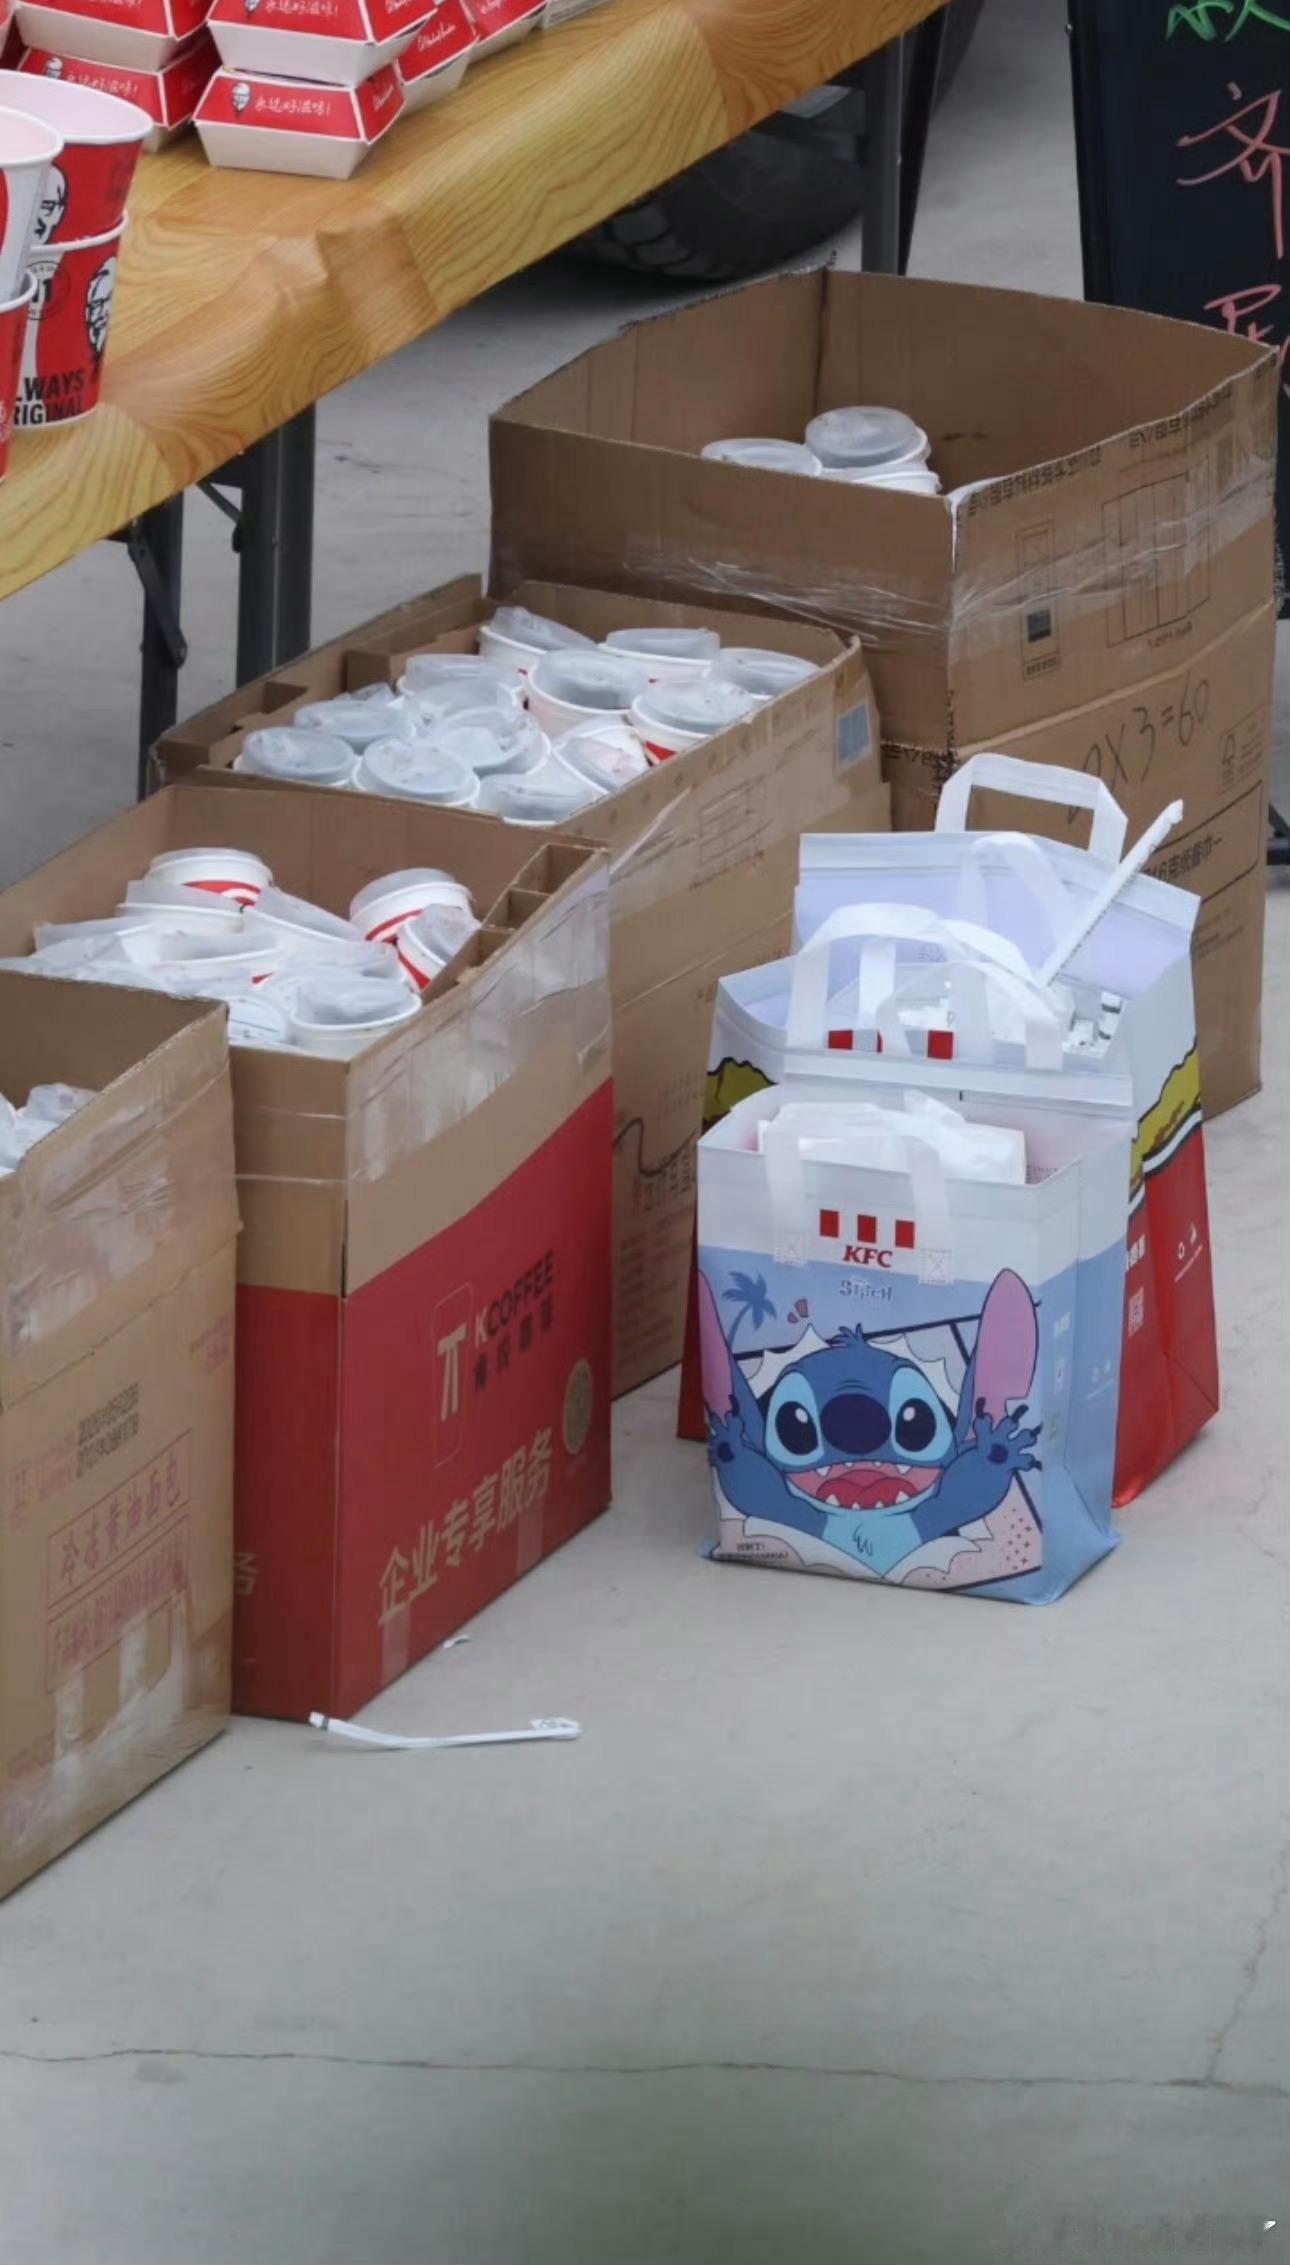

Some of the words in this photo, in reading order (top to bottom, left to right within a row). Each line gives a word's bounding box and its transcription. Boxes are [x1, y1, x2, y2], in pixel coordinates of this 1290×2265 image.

[16, 368, 85, 402] WAYS
[842, 1245, 893, 1268] KFC
[474, 1249, 554, 1348] KCOFFEE
[378, 1427, 553, 1627] 企业专享服务
